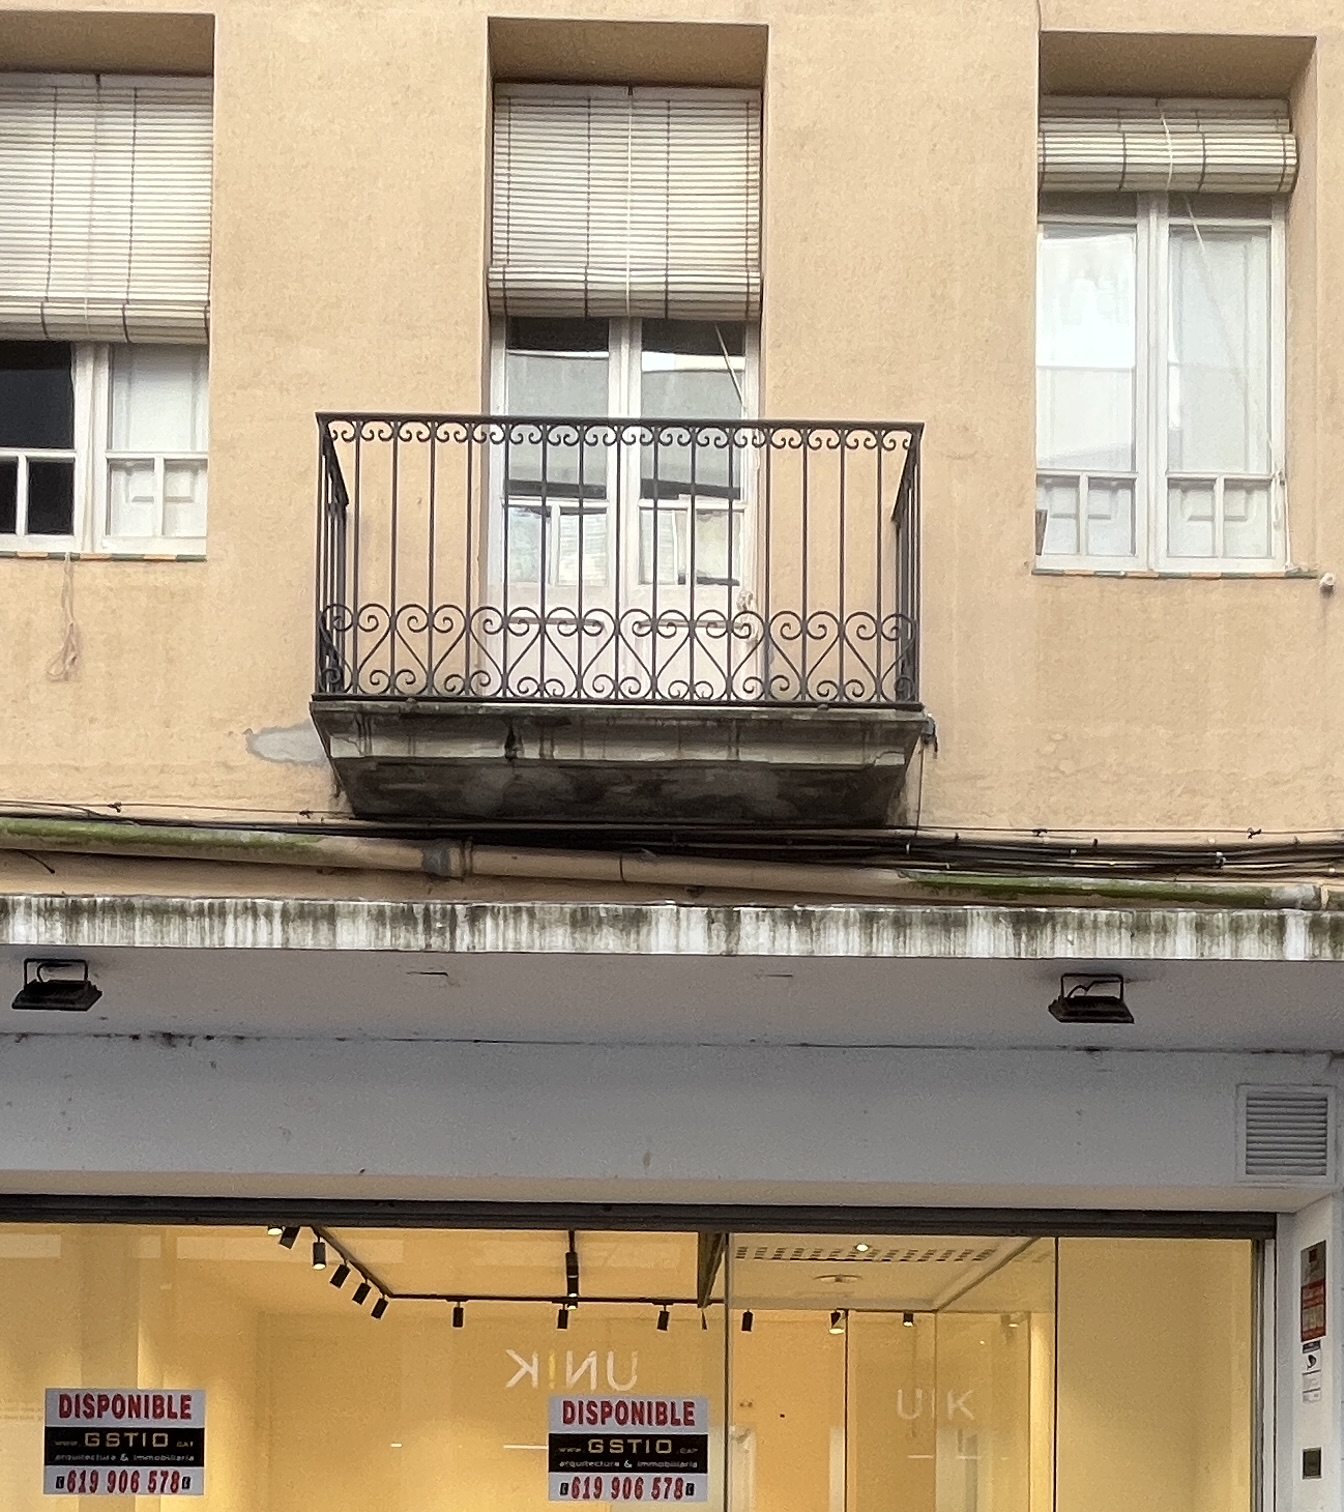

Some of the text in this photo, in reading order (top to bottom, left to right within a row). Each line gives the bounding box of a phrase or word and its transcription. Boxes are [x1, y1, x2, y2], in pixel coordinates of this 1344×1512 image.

[59, 1394, 192, 1419] DISPONIBLE
[562, 1400, 695, 1426] DISPONIBLE
[84, 1432, 169, 1447] GSTIO
[587, 1439, 673, 1454] GSTIO
[119, 1453, 129, 1462] &
[623, 1459, 633, 1468] &
[67, 1469, 180, 1493] 619 906 578
[571, 1476, 684, 1499] 619 906 578
